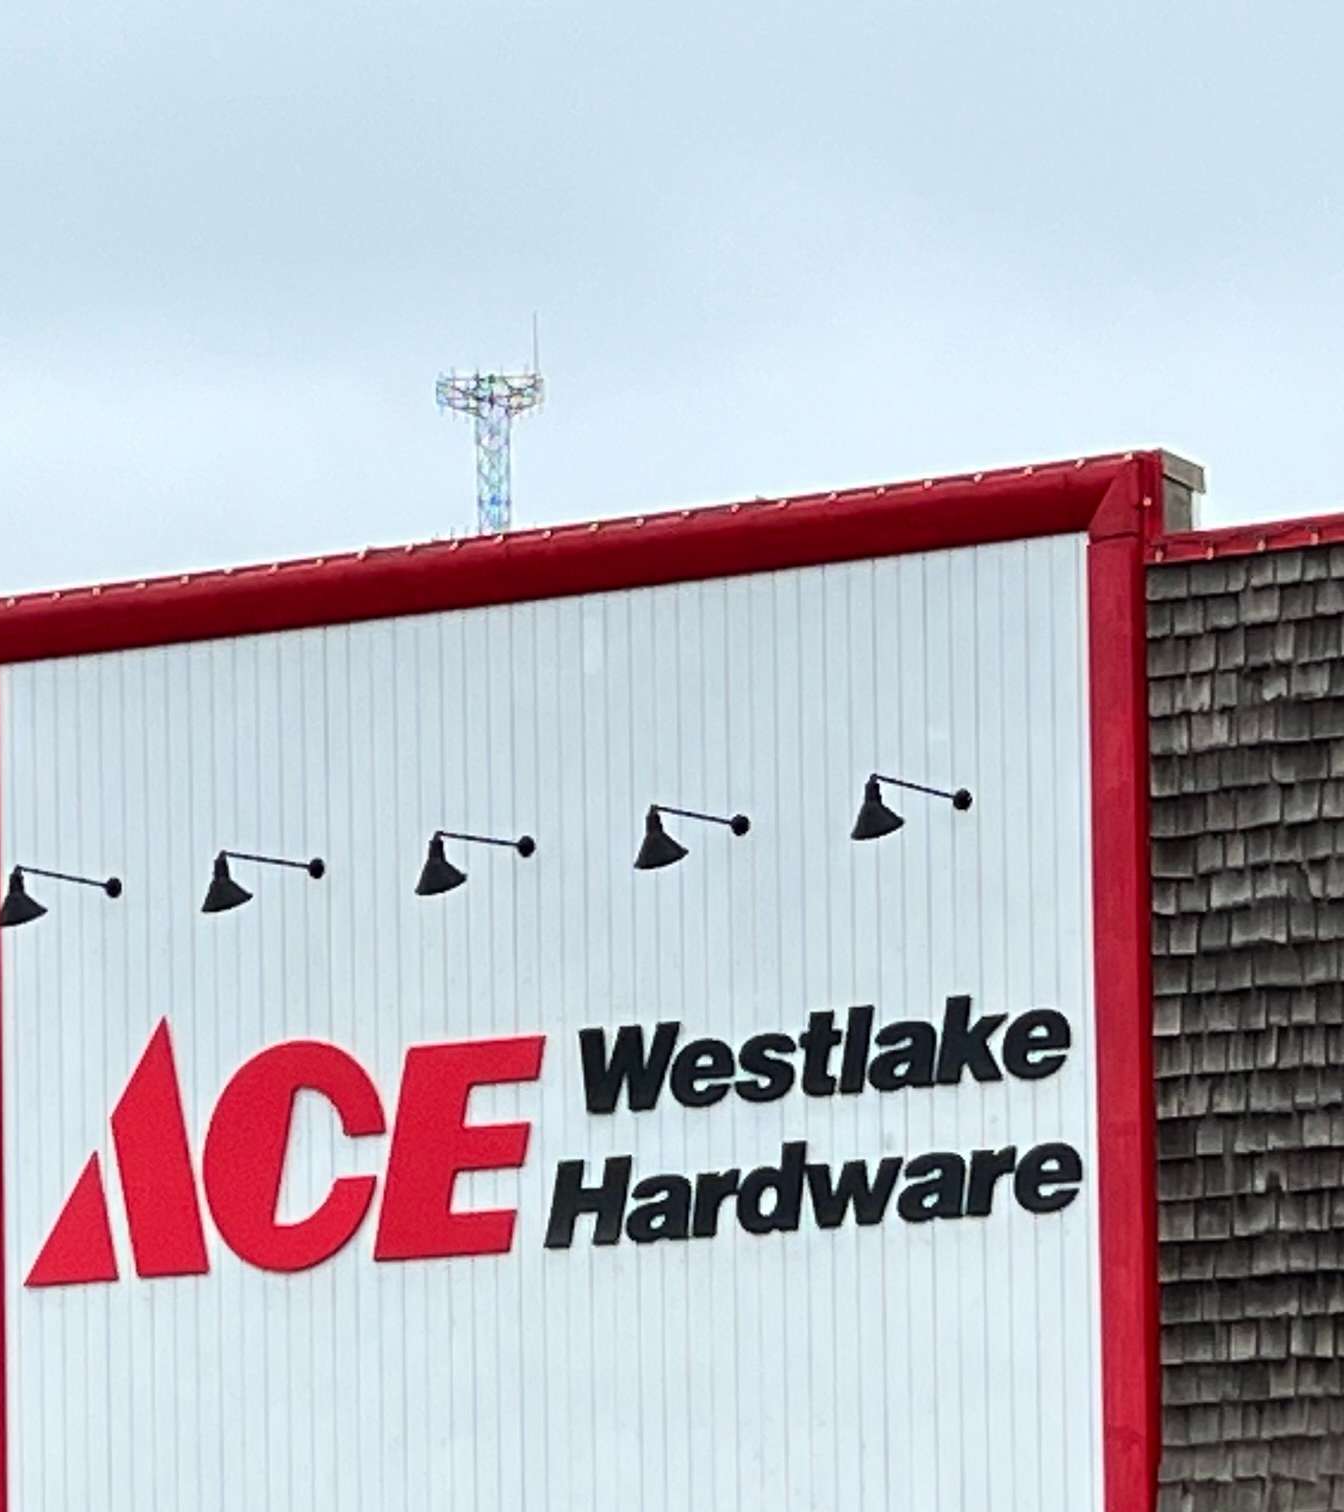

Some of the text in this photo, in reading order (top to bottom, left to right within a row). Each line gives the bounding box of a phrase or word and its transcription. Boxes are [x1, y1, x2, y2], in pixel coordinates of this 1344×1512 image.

[577, 996, 1071, 1114] Westlake
[24, 1016, 545, 1286] ACE
[544, 1141, 1082, 1249] Hardware
